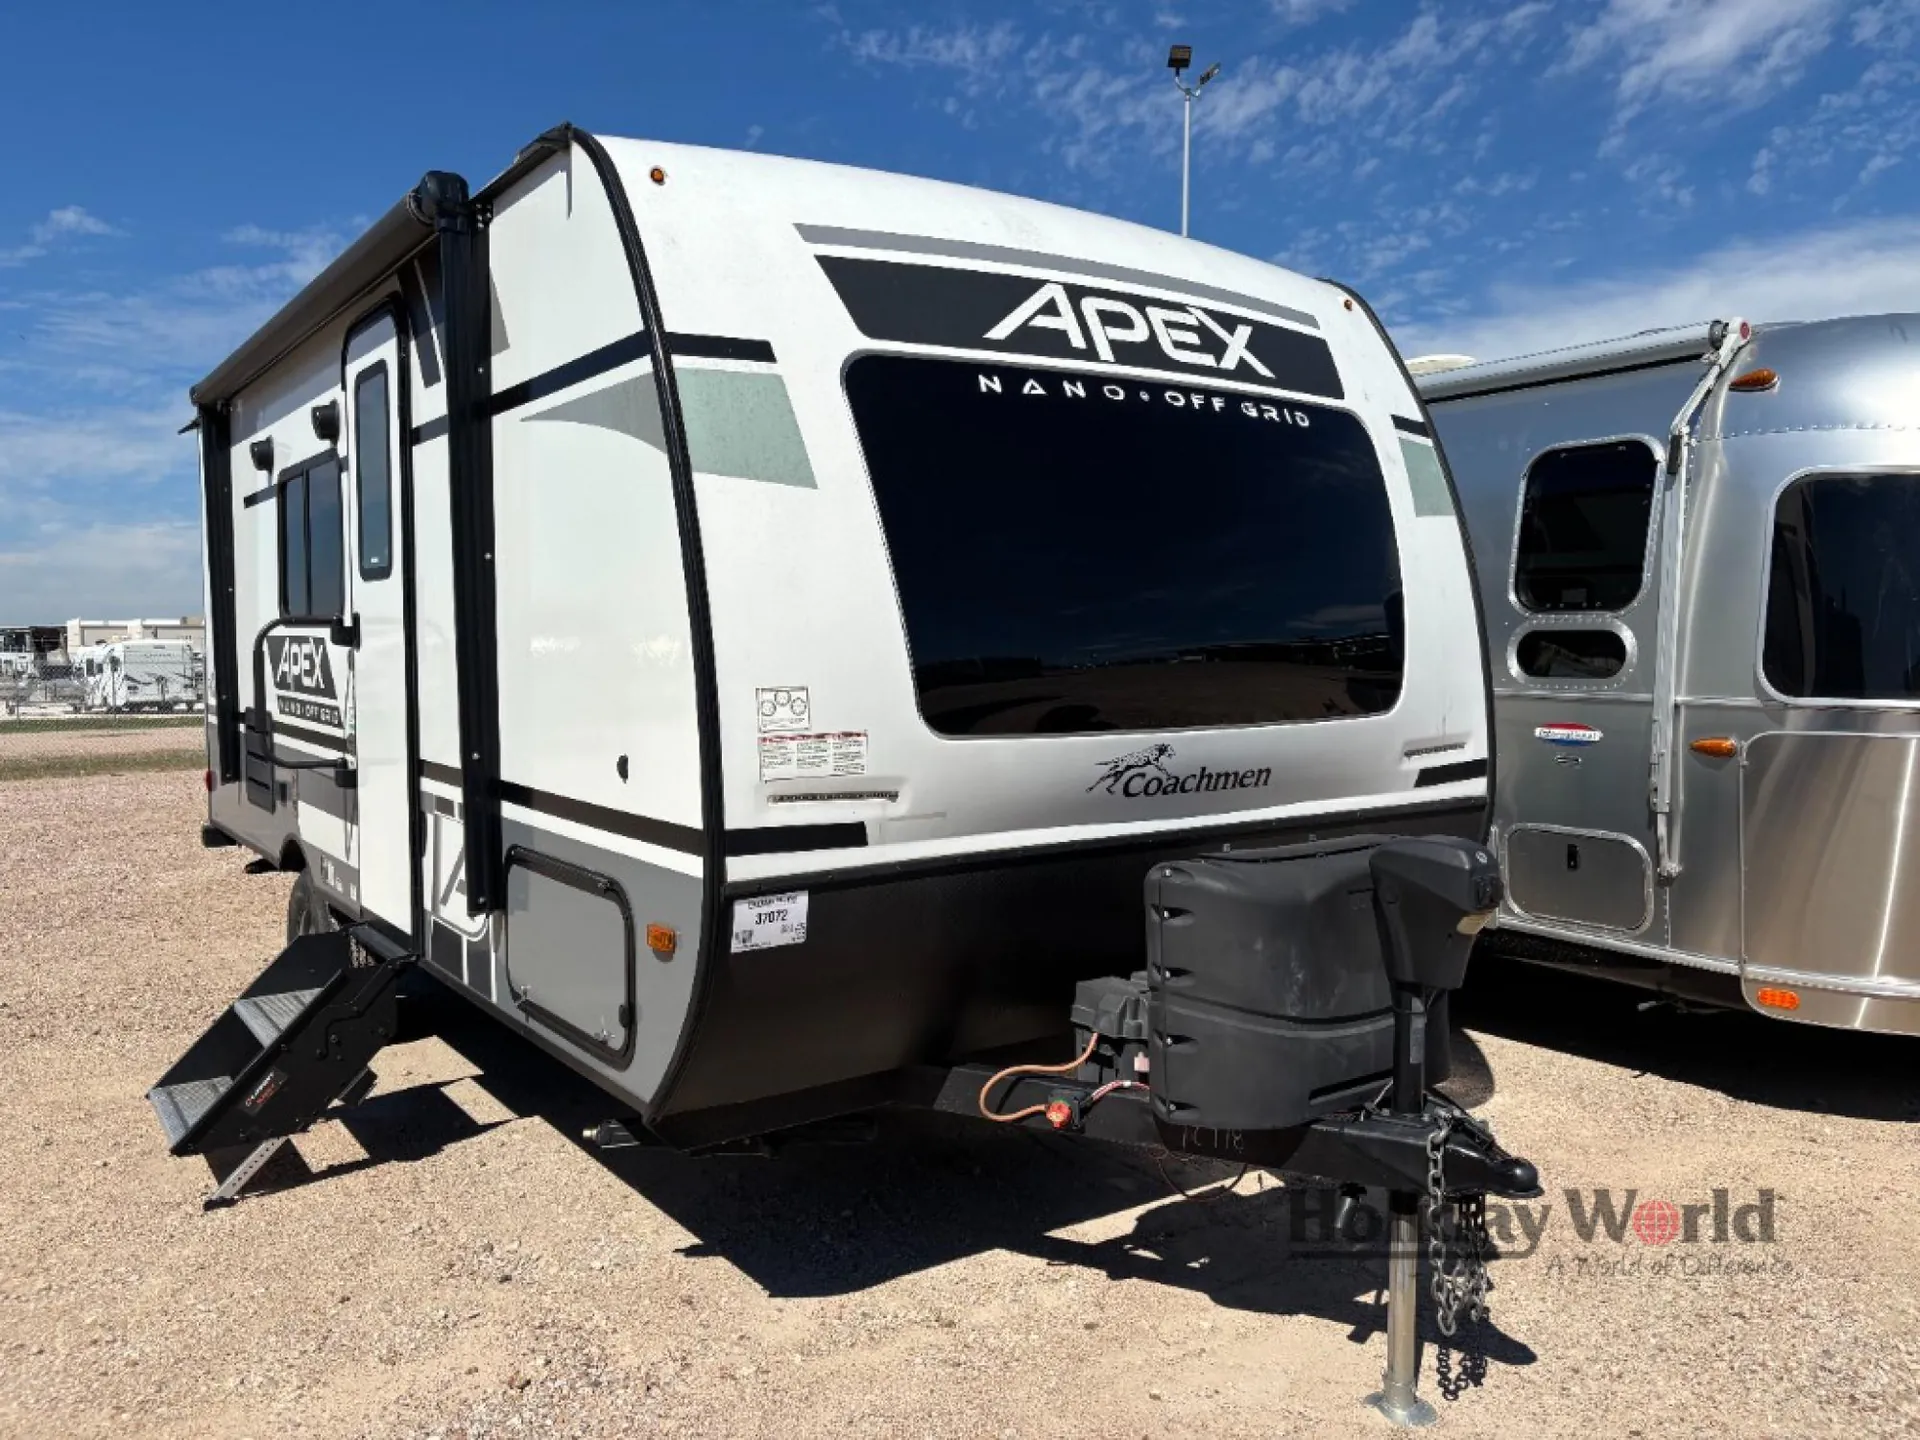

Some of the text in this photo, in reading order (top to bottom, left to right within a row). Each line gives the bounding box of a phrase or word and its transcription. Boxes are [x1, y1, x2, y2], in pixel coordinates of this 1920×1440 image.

[982, 282, 1276, 379] APEX
[978, 374, 1310, 427] NANO OFF GRID
[276, 636, 325, 691] APEX
[1122, 766, 1272, 798] Coachmen
